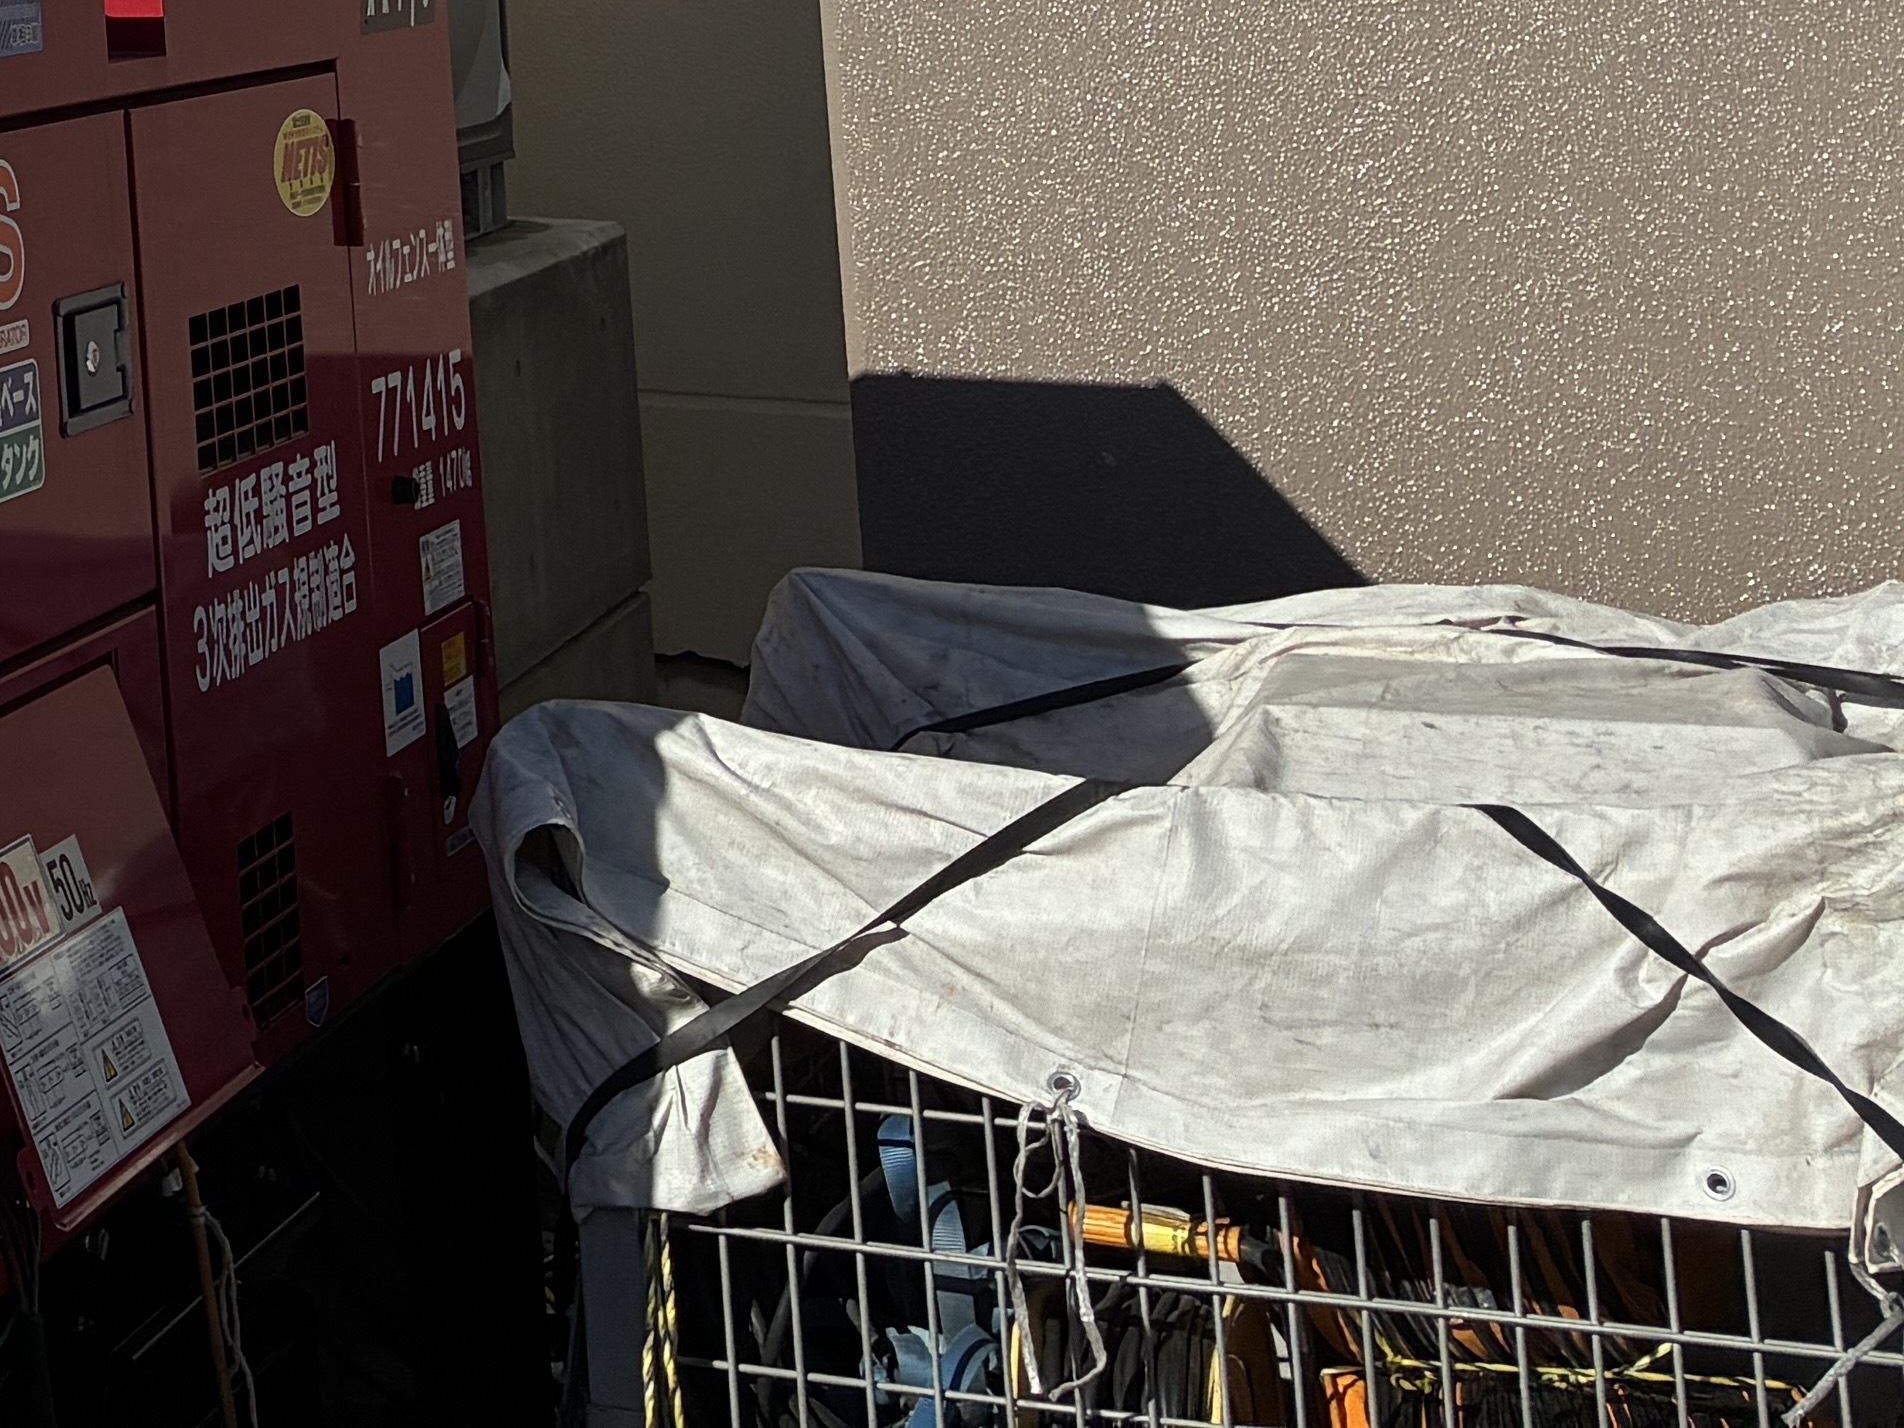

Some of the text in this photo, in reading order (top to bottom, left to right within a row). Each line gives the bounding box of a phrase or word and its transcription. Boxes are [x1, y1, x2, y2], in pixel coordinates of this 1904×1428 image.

[370, 347, 466, 464] 771415
[203, 439, 341, 579] 超低騒音型
